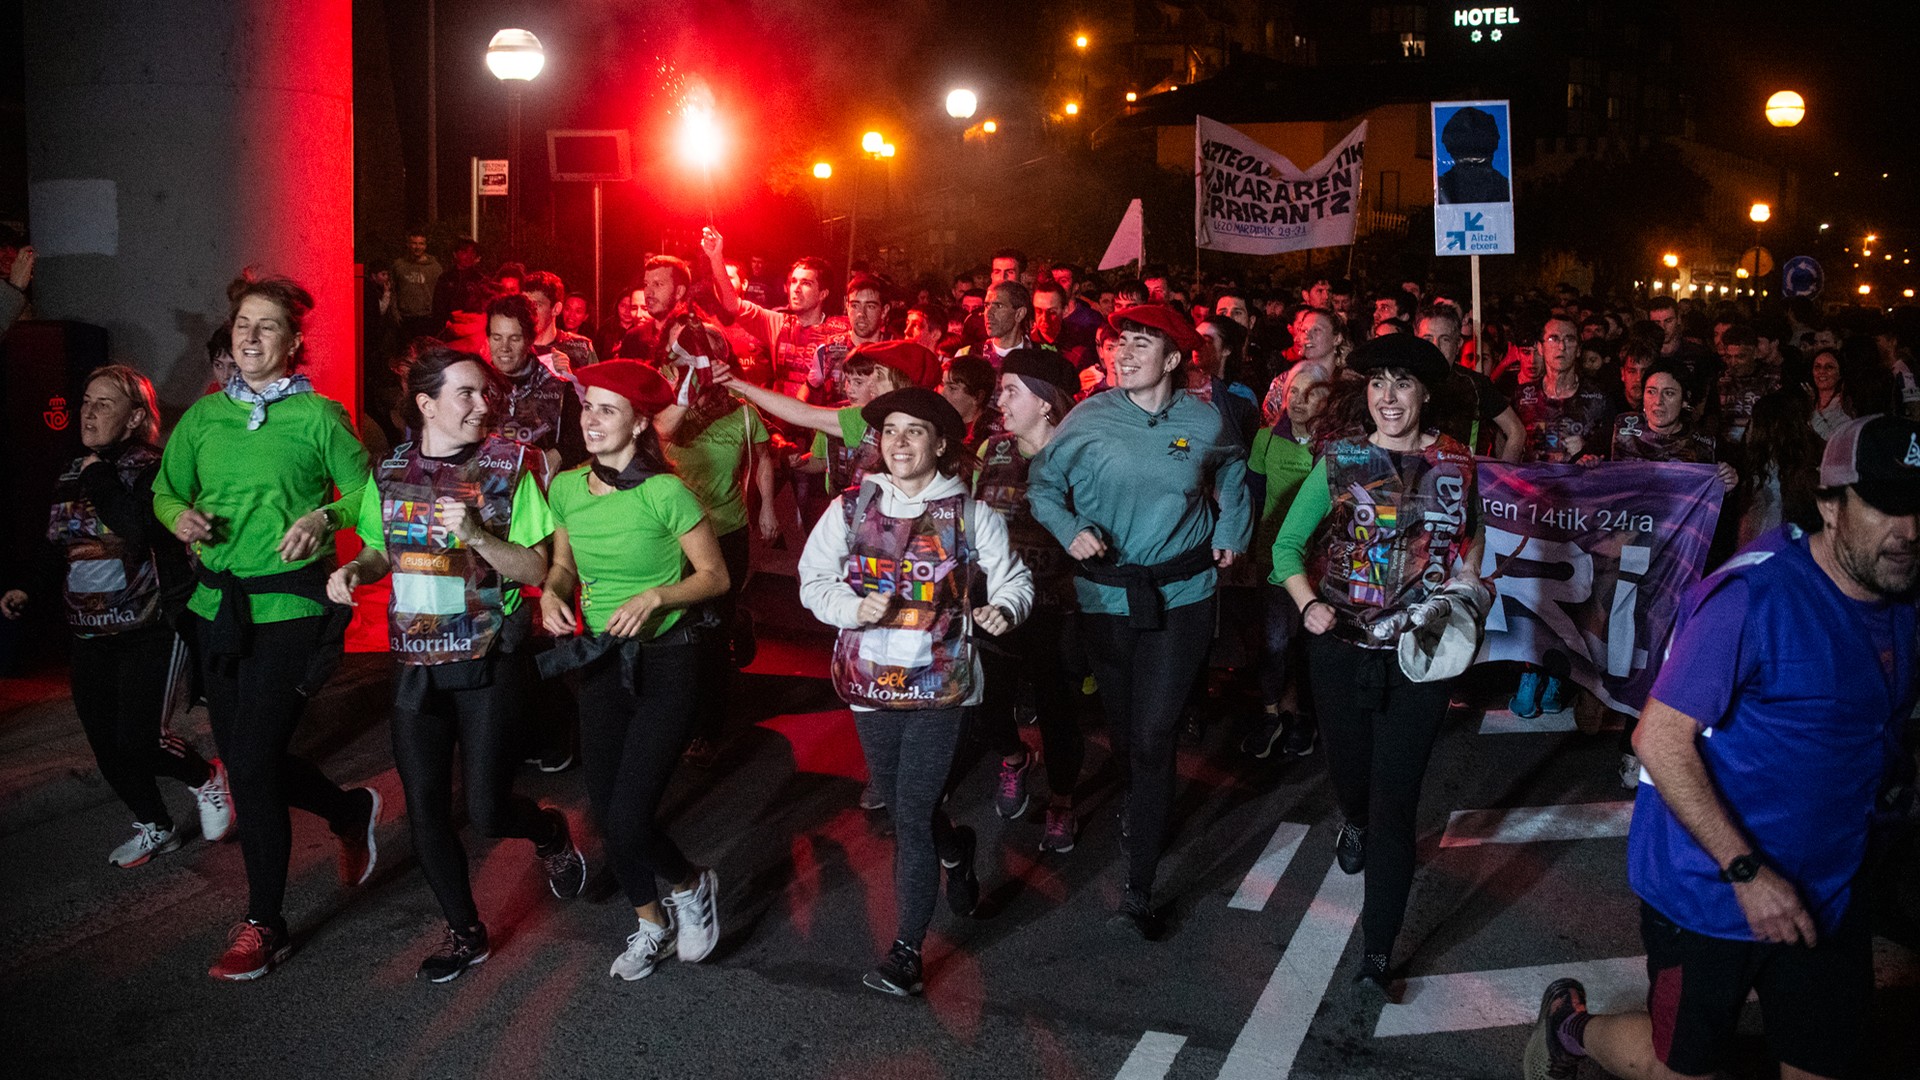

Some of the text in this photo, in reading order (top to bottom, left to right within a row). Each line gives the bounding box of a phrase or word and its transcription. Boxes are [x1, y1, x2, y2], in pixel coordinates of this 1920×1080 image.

[1454, 7, 1520, 26] HOTEL
[1471, 241, 1498, 251] etxera
[490, 457, 513, 470] eitb
[1528, 503, 1588, 532] 14tik
[1597, 509, 1653, 533] 24ra
[877, 669, 909, 688] aek
[848, 681, 935, 701] 23.korrika
